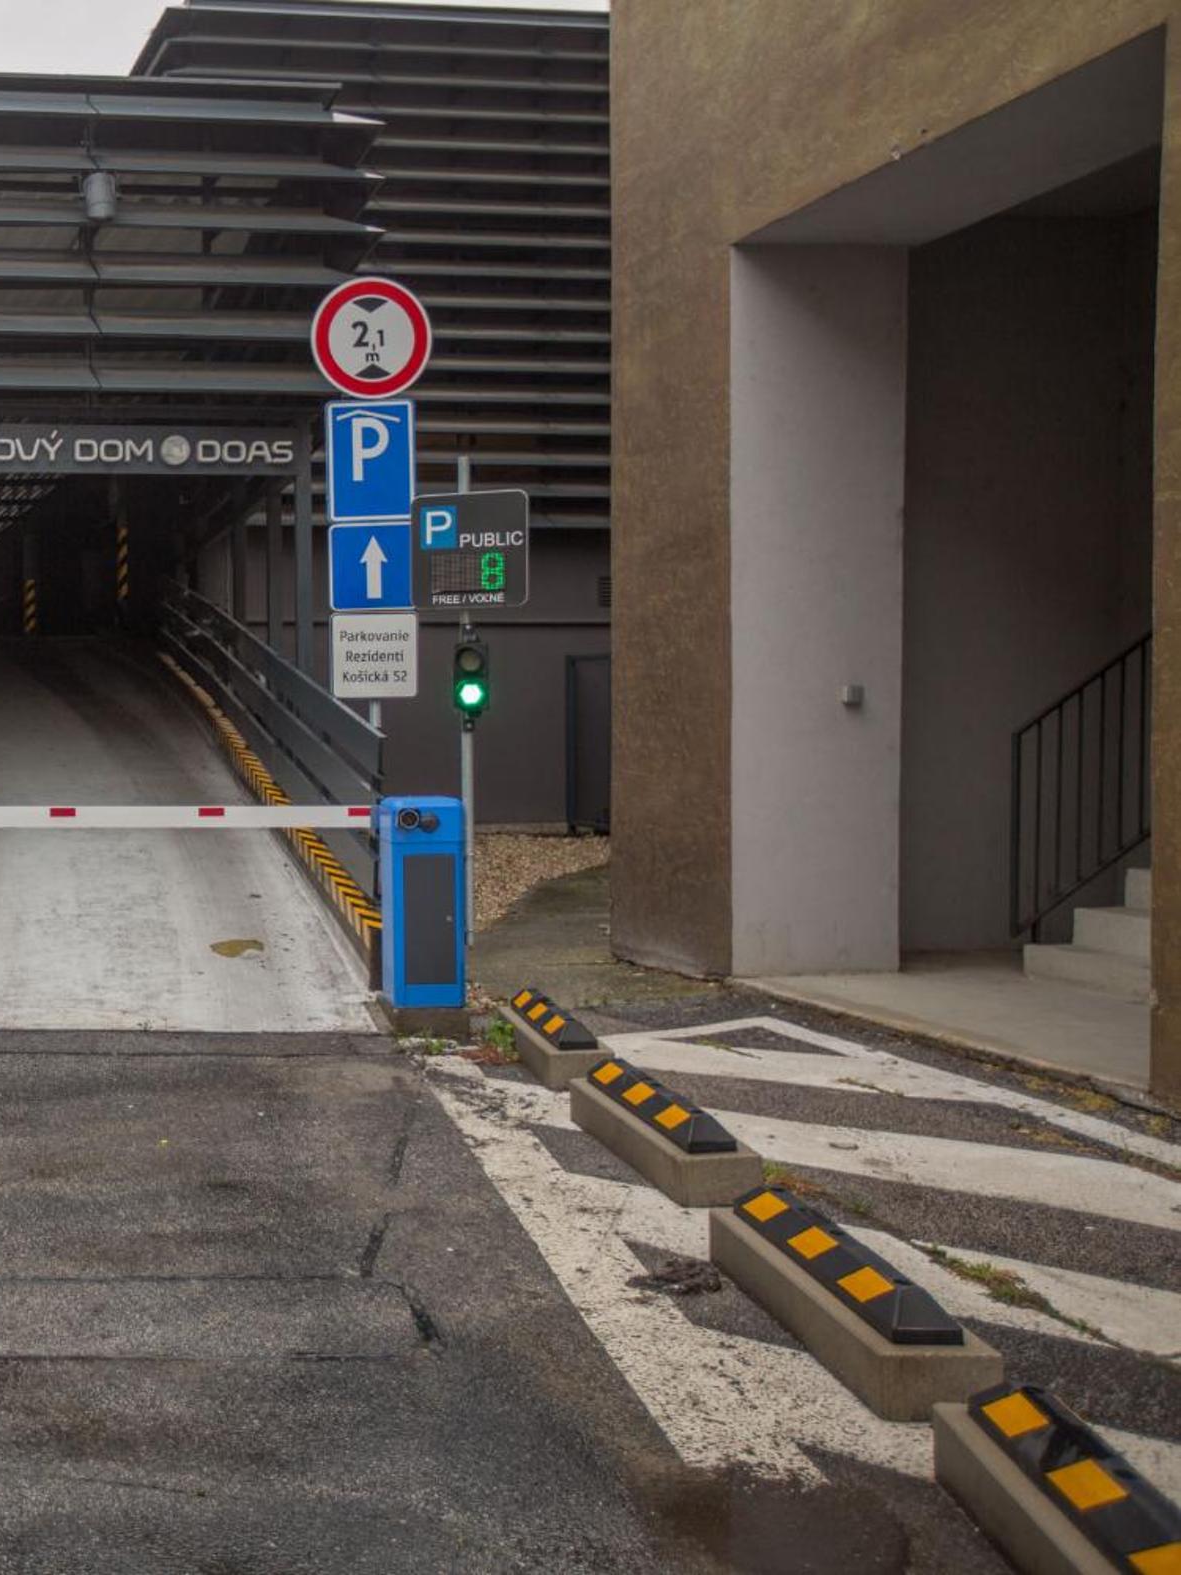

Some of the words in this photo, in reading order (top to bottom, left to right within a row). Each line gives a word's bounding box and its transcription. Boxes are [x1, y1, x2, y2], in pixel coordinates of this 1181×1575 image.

[351, 320, 385, 350] 2,1
[365, 351, 380, 362] m
[74, 439, 154, 463] DOM
[196, 440, 294, 463] DOAS
[351, 417, 390, 482] P
[426, 510, 453, 545] P
[459, 530, 524, 549] PUBLIC
[481, 552, 505, 590] 8
[432, 593, 460, 605] FREE
[339, 629, 410, 642] Parkovanie
[345, 649, 404, 663] Rezidenti
[342, 669, 389, 683] Košická
[392, 669, 408, 682] 52
